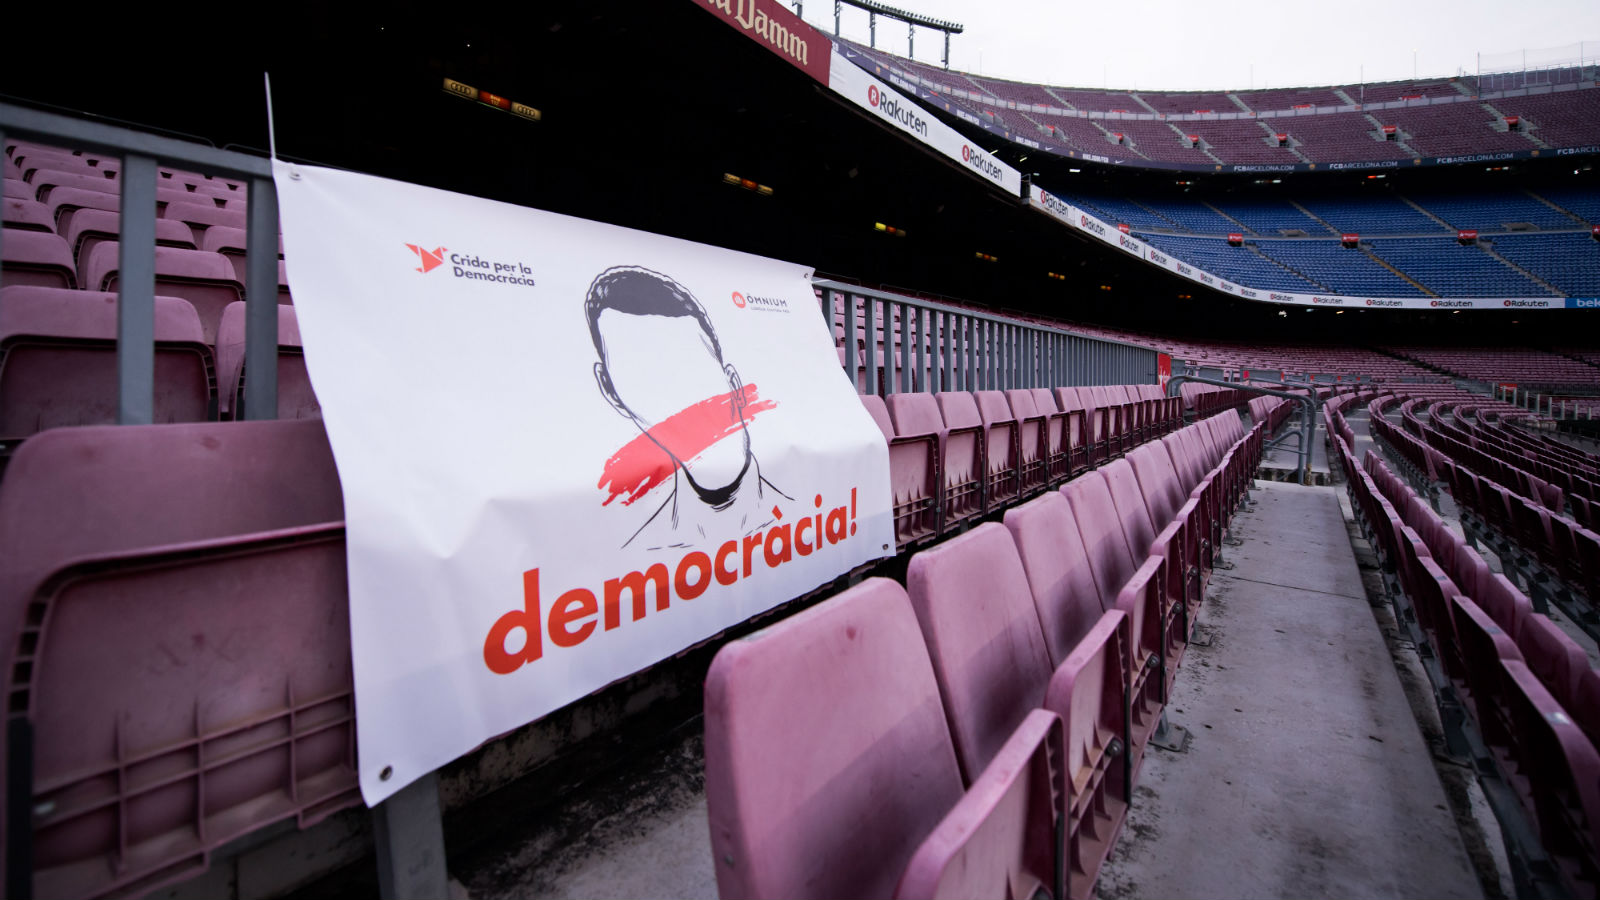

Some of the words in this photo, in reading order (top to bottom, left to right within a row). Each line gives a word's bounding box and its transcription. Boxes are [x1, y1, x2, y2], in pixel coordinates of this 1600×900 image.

[734, 0, 808, 66] Damm
[880, 92, 928, 137] Rakuten
[970, 149, 1003, 181] Rakuten
[1330, 161, 1398, 170] FCBARCELONA.COM
[1437, 153, 1514, 164] FCBARCELONA.COM
[1046, 193, 1069, 216] Rakuten
[1085, 217, 1106, 237] Rakuten
[450, 253, 490, 269] Crida
[493, 262, 517, 274] per
[519, 262, 532, 275] la
[453, 266, 535, 287] Democràcia
[1274, 293, 1294, 302] Rakuten
[1318, 297, 1343, 305] Rakuten
[1372, 299, 1403, 307] Rakuten
[1511, 299, 1549, 308] Rakuten
[483, 487, 857, 675] democràcia!
